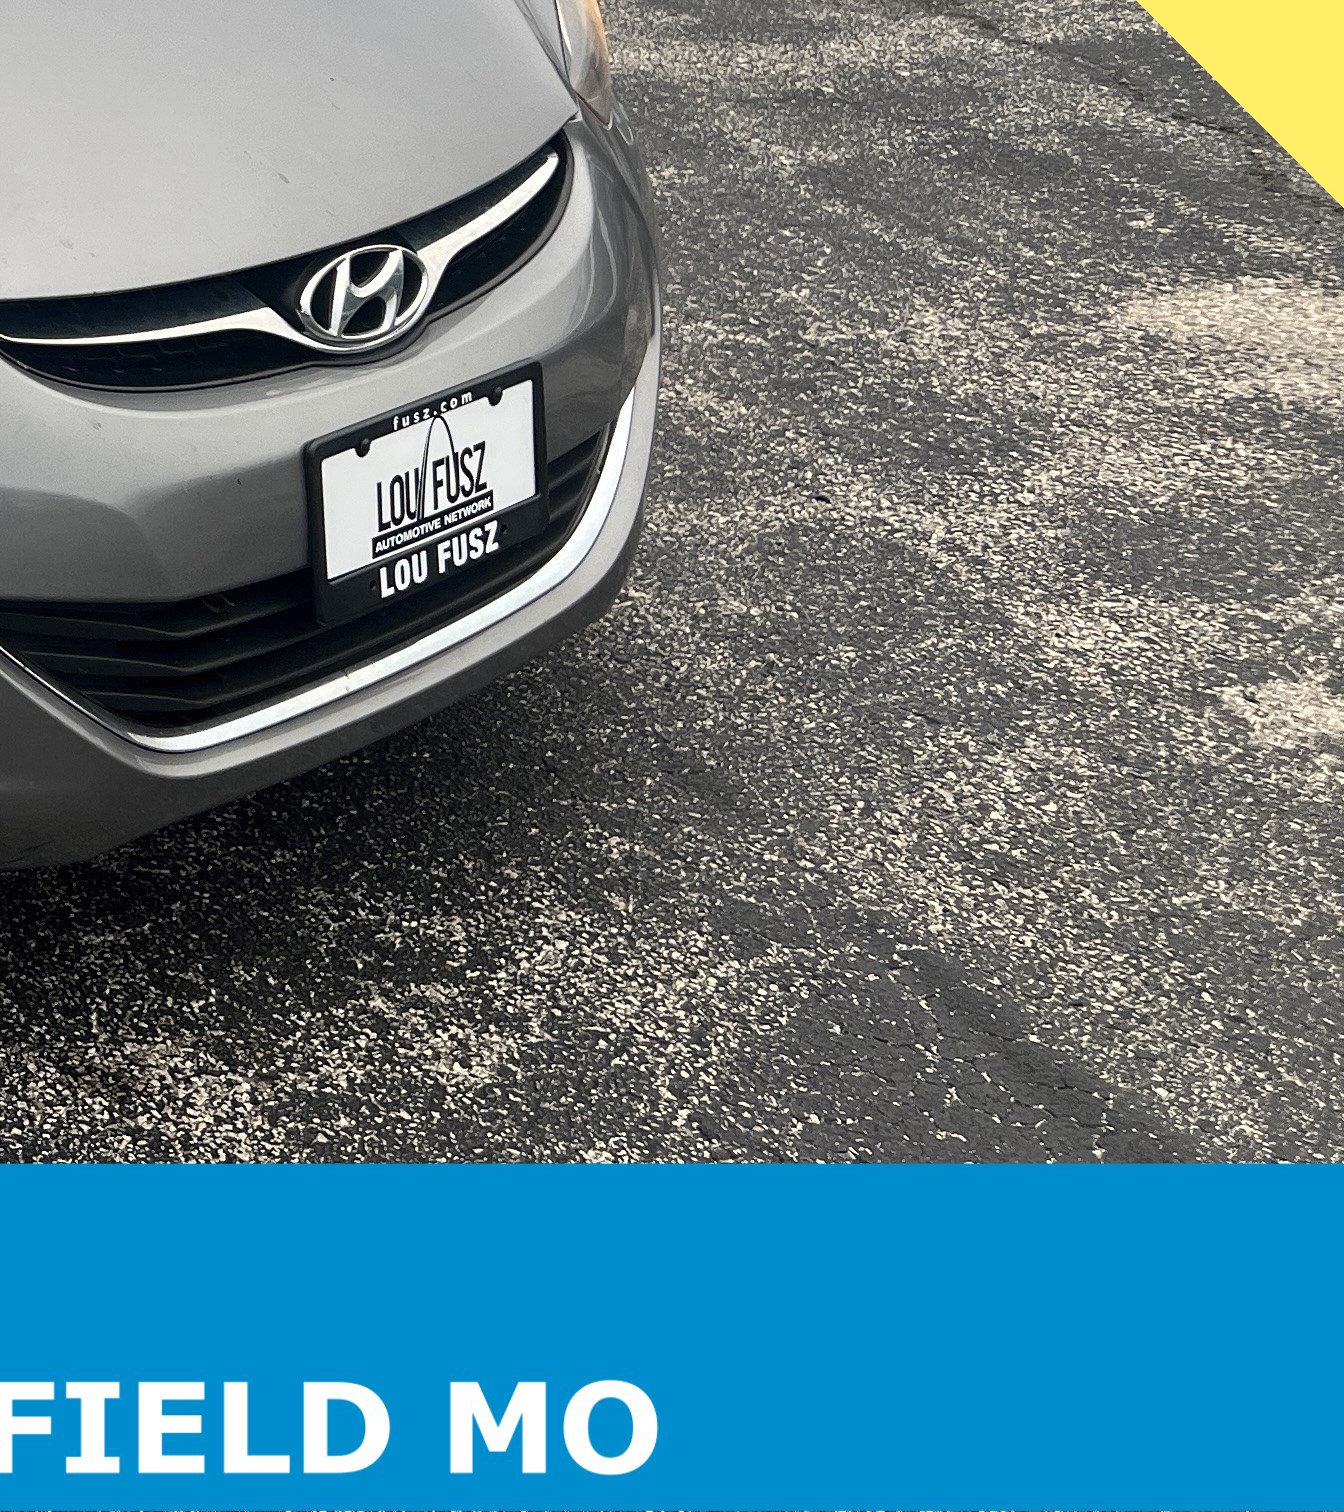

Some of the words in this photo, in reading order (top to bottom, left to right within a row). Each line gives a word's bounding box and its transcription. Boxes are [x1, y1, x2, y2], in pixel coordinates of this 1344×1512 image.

[392, 390, 474, 431] fusz.com
[376, 465, 424, 532] LOU
[432, 440, 488, 511] FUSZ
[374, 519, 442, 554] AUTOMOTIVE
[443, 495, 493, 527] NETWORK
[378, 550, 429, 599] LOU
[436, 519, 500, 574] FUSZ
